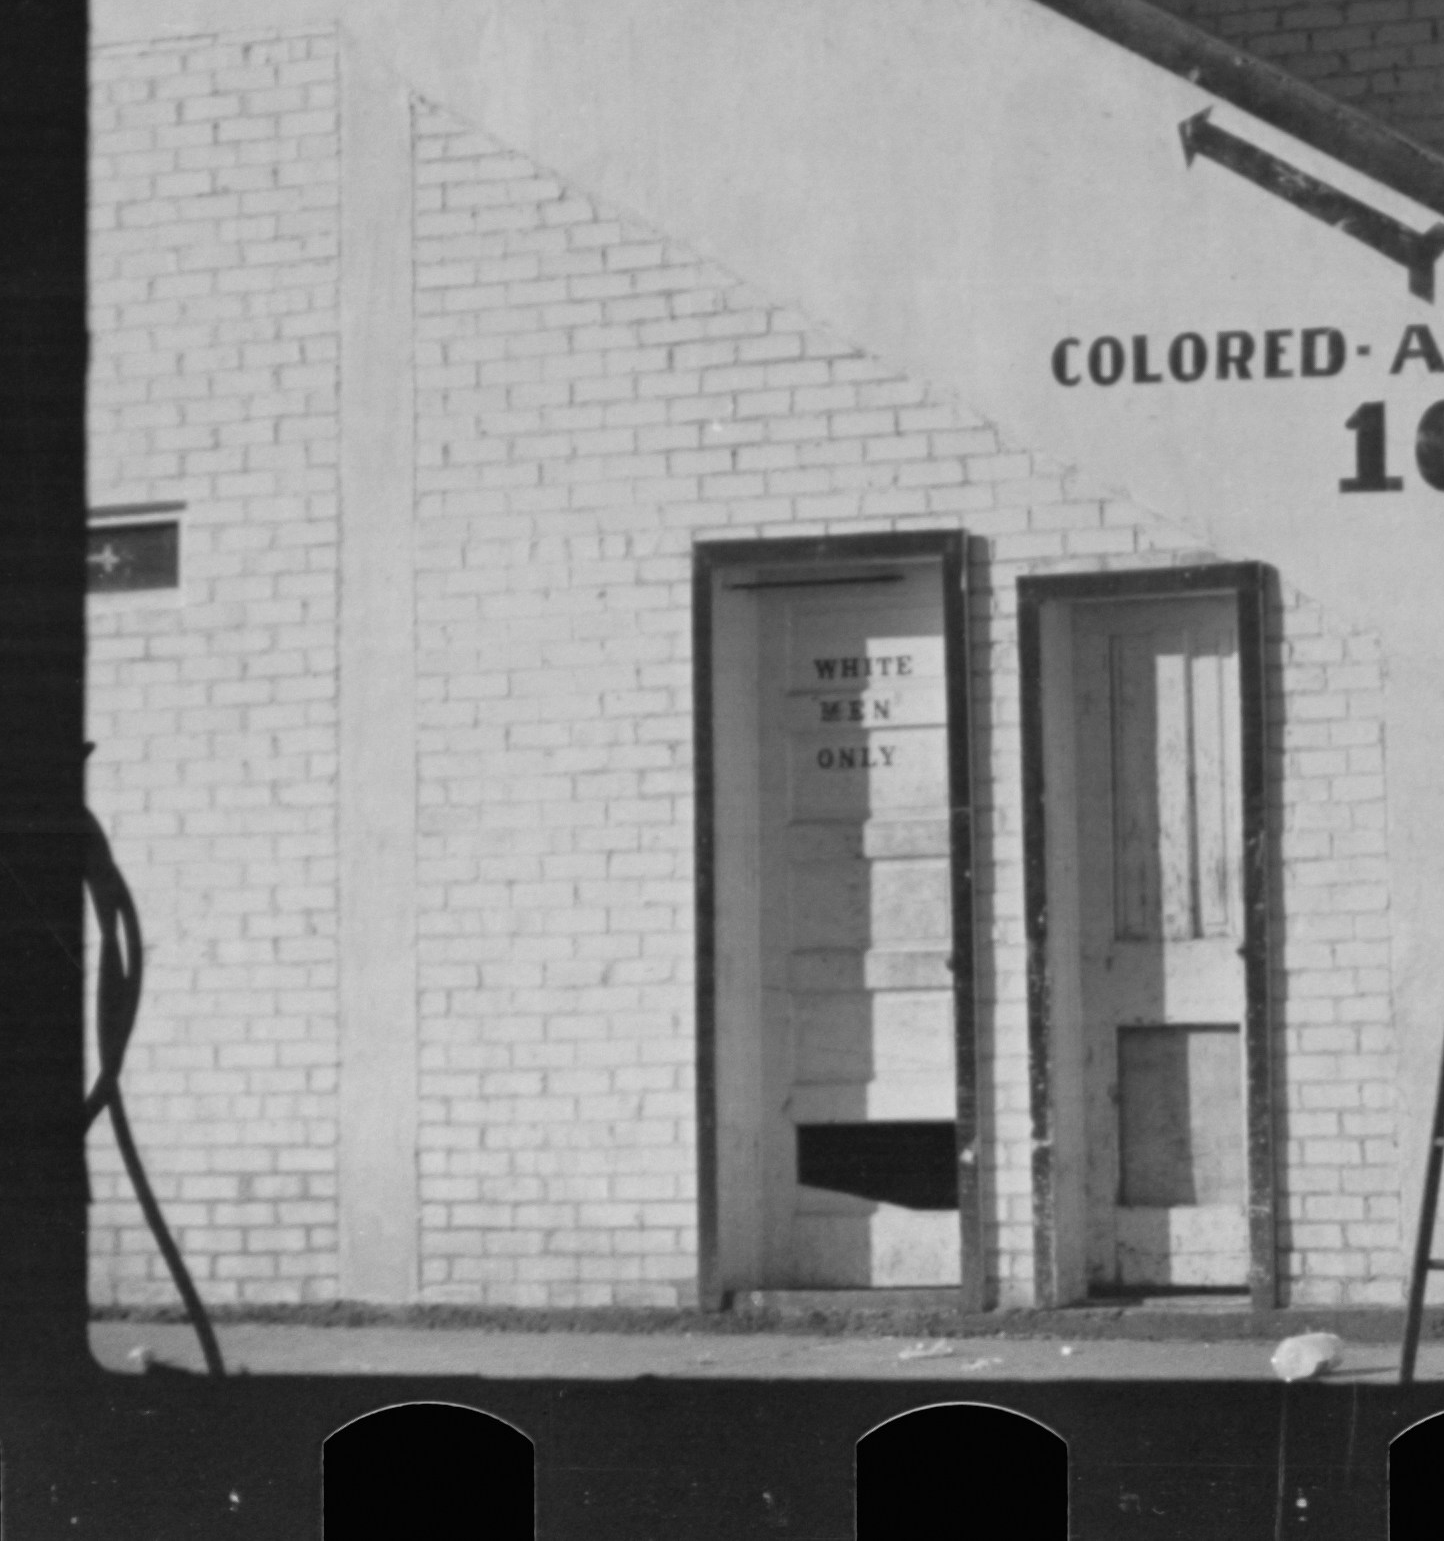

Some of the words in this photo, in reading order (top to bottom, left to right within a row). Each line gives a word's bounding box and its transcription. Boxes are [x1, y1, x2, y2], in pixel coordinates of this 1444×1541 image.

[813, 655, 913, 680] WHITE
[819, 699, 891, 723] MEN
[816, 744, 897, 770] ONLY
